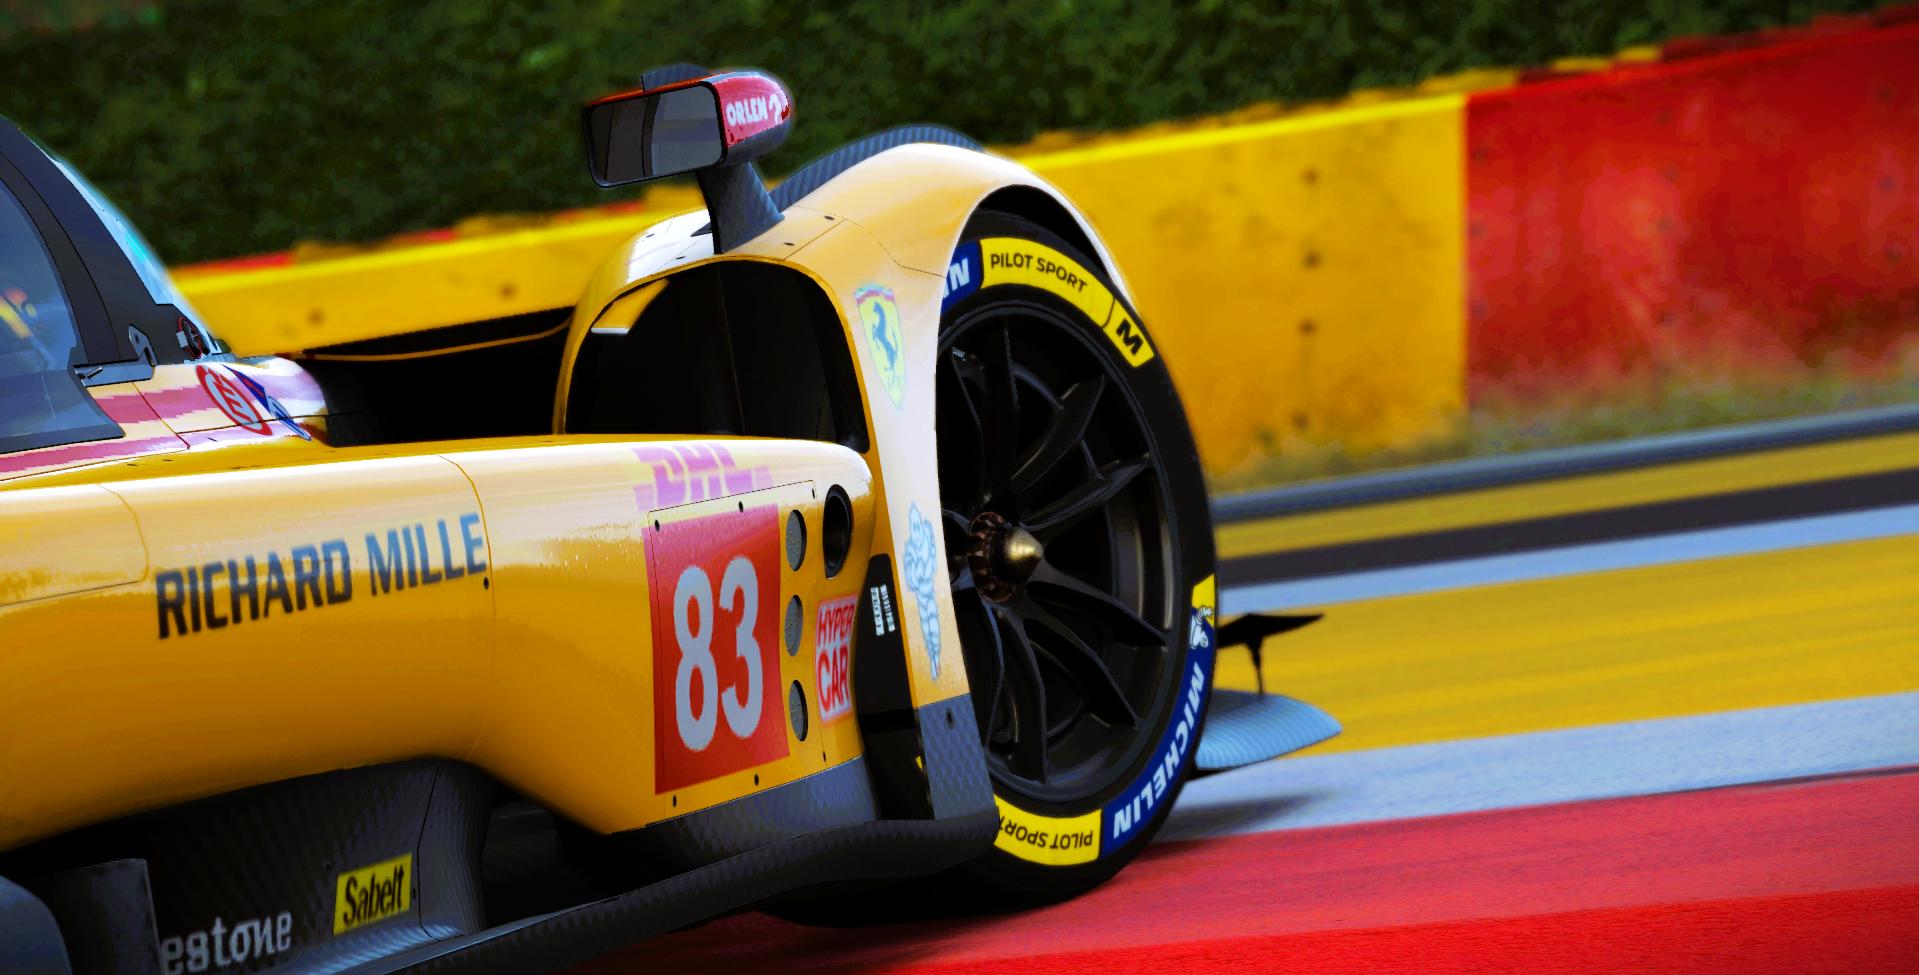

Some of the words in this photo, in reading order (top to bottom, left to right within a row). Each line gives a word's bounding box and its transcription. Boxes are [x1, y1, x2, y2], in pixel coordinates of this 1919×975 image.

[726, 99, 768, 127] ORLEN
[990, 252, 1033, 270] PILOT
[1036, 257, 1088, 292] SPORT
[1116, 318, 1144, 355] M
[155, 538, 352, 639] RICHARD
[365, 512, 487, 596] MILLE
[817, 603, 856, 647] HYPER
[673, 556, 763, 751] 83
[818, 644, 851, 713] CAR
[1113, 662, 1205, 839] MICHELIN
[1049, 829, 1094, 850] PILOT
[344, 866, 405, 926] Sabelt
